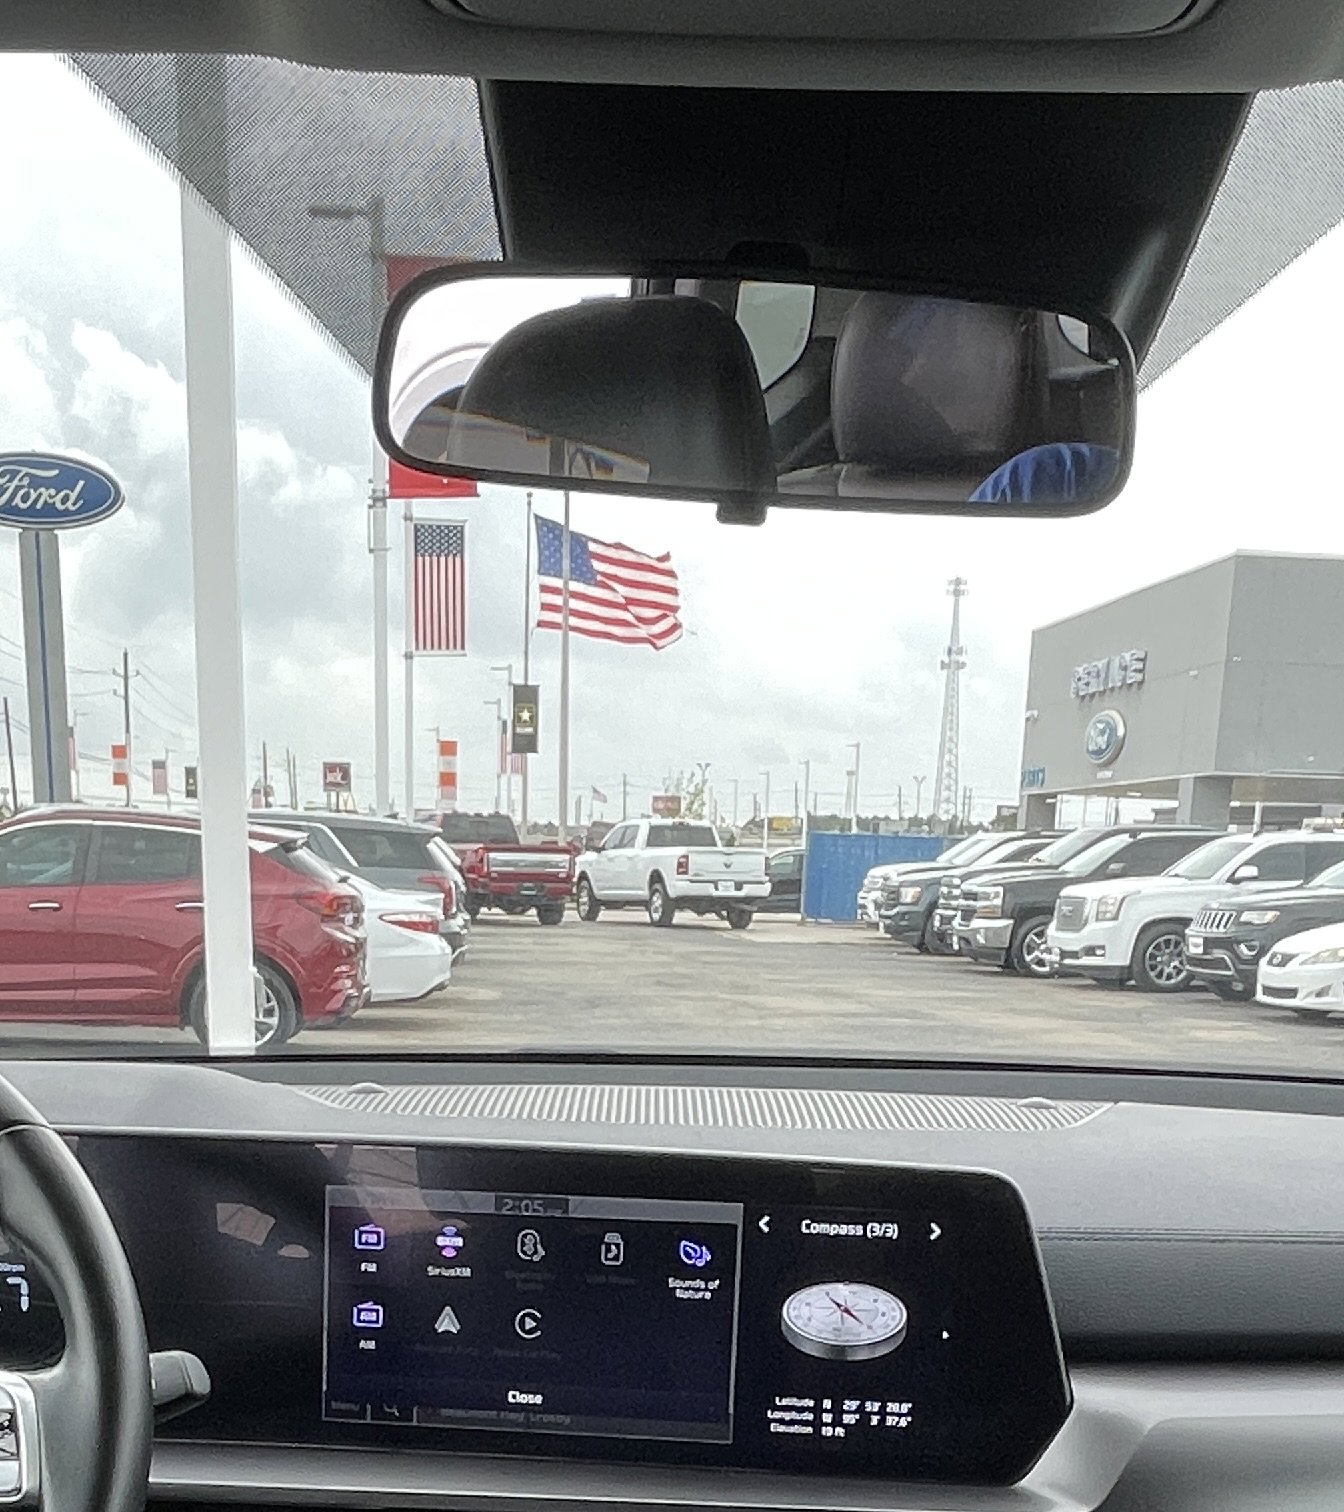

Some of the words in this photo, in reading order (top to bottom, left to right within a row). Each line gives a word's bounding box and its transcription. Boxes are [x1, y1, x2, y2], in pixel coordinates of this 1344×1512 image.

[502, 1198, 545, 1215] 2:05
[800, 1218, 864, 1237] Compass
[866, 1221, 899, 1240] (3/3)
[668, 1277, 706, 1290] Sounds
[506, 1389, 544, 1405] Close
